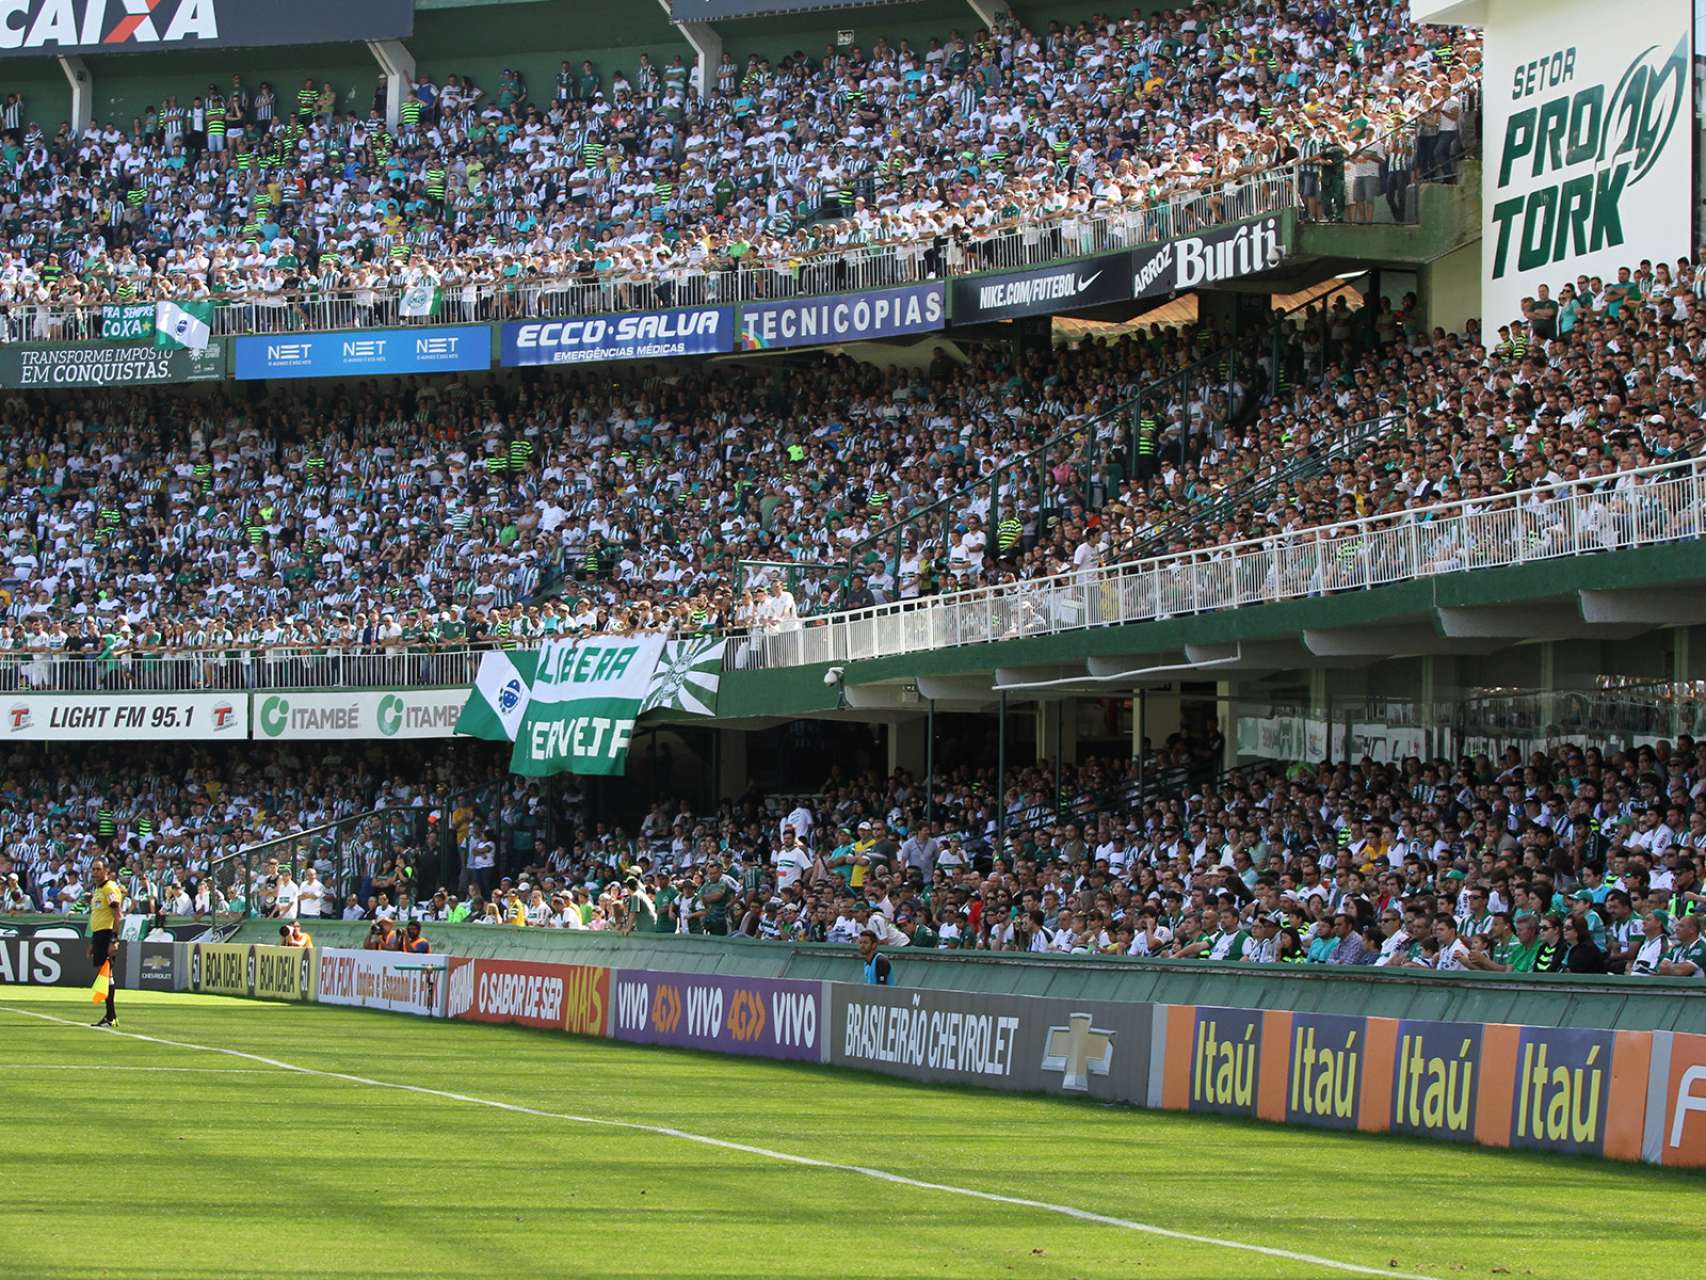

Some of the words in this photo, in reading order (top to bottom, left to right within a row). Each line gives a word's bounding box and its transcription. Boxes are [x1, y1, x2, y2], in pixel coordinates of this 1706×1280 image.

[0, 0, 218, 48] CAIXA
[1513, 46, 1577, 100] SETOR
[1498, 83, 1605, 189] PRO
[1492, 161, 1633, 280] TORK
[1134, 243, 1172, 298] ARROZ
[1174, 218, 1280, 289] Buriti
[103, 306, 120, 318] PRA
[980, 273, 1076, 309] NIKE.COM/FUTEBOL
[744, 292, 941, 341] TECNICÓPIAS
[21, 349, 114, 365] TRANSFORME
[268, 344, 312, 360] NET
[343, 341, 387, 356] NET
[417, 337, 459, 353] NET
[554, 347, 633, 361] EMERGÊNCIAS
[637, 343, 685, 357] MÉDICAS
[21, 365, 51, 383] EM
[54, 360, 172, 384] CONQUISTAS.
[536, 645, 640, 685] LIBERA
[50, 706, 110, 728] LIGHT
[114, 706, 147, 728] FM
[151, 706, 194, 728] 95.1
[292, 703, 358, 730] ITAMBÉ
[406, 704, 465, 728] ITAMB
[206, 952, 221, 987] BOA
[223, 953, 242, 988] IDEIA
[260, 955, 274, 991] BOA
[479, 972, 488, 1013] O
[488, 973, 526, 1016] SABOR
[525, 976, 541, 1018] DE
[540, 977, 563, 1021] SER
[565, 965, 604, 1035] MAIS
[618, 982, 649, 1031] VIVO
[687, 986, 724, 1038] VIVO
[772, 991, 816, 1048] VIVO
[845, 993, 928, 1067] BRASILEIRÃO
[928, 1011, 1019, 1075] CHEVROLET
[1194, 1020, 1255, 1106] Itaú
[1291, 1027, 1357, 1118] Itaú
[1396, 1035, 1472, 1131] Itaú
[1517, 1043, 1601, 1143] Itaú
